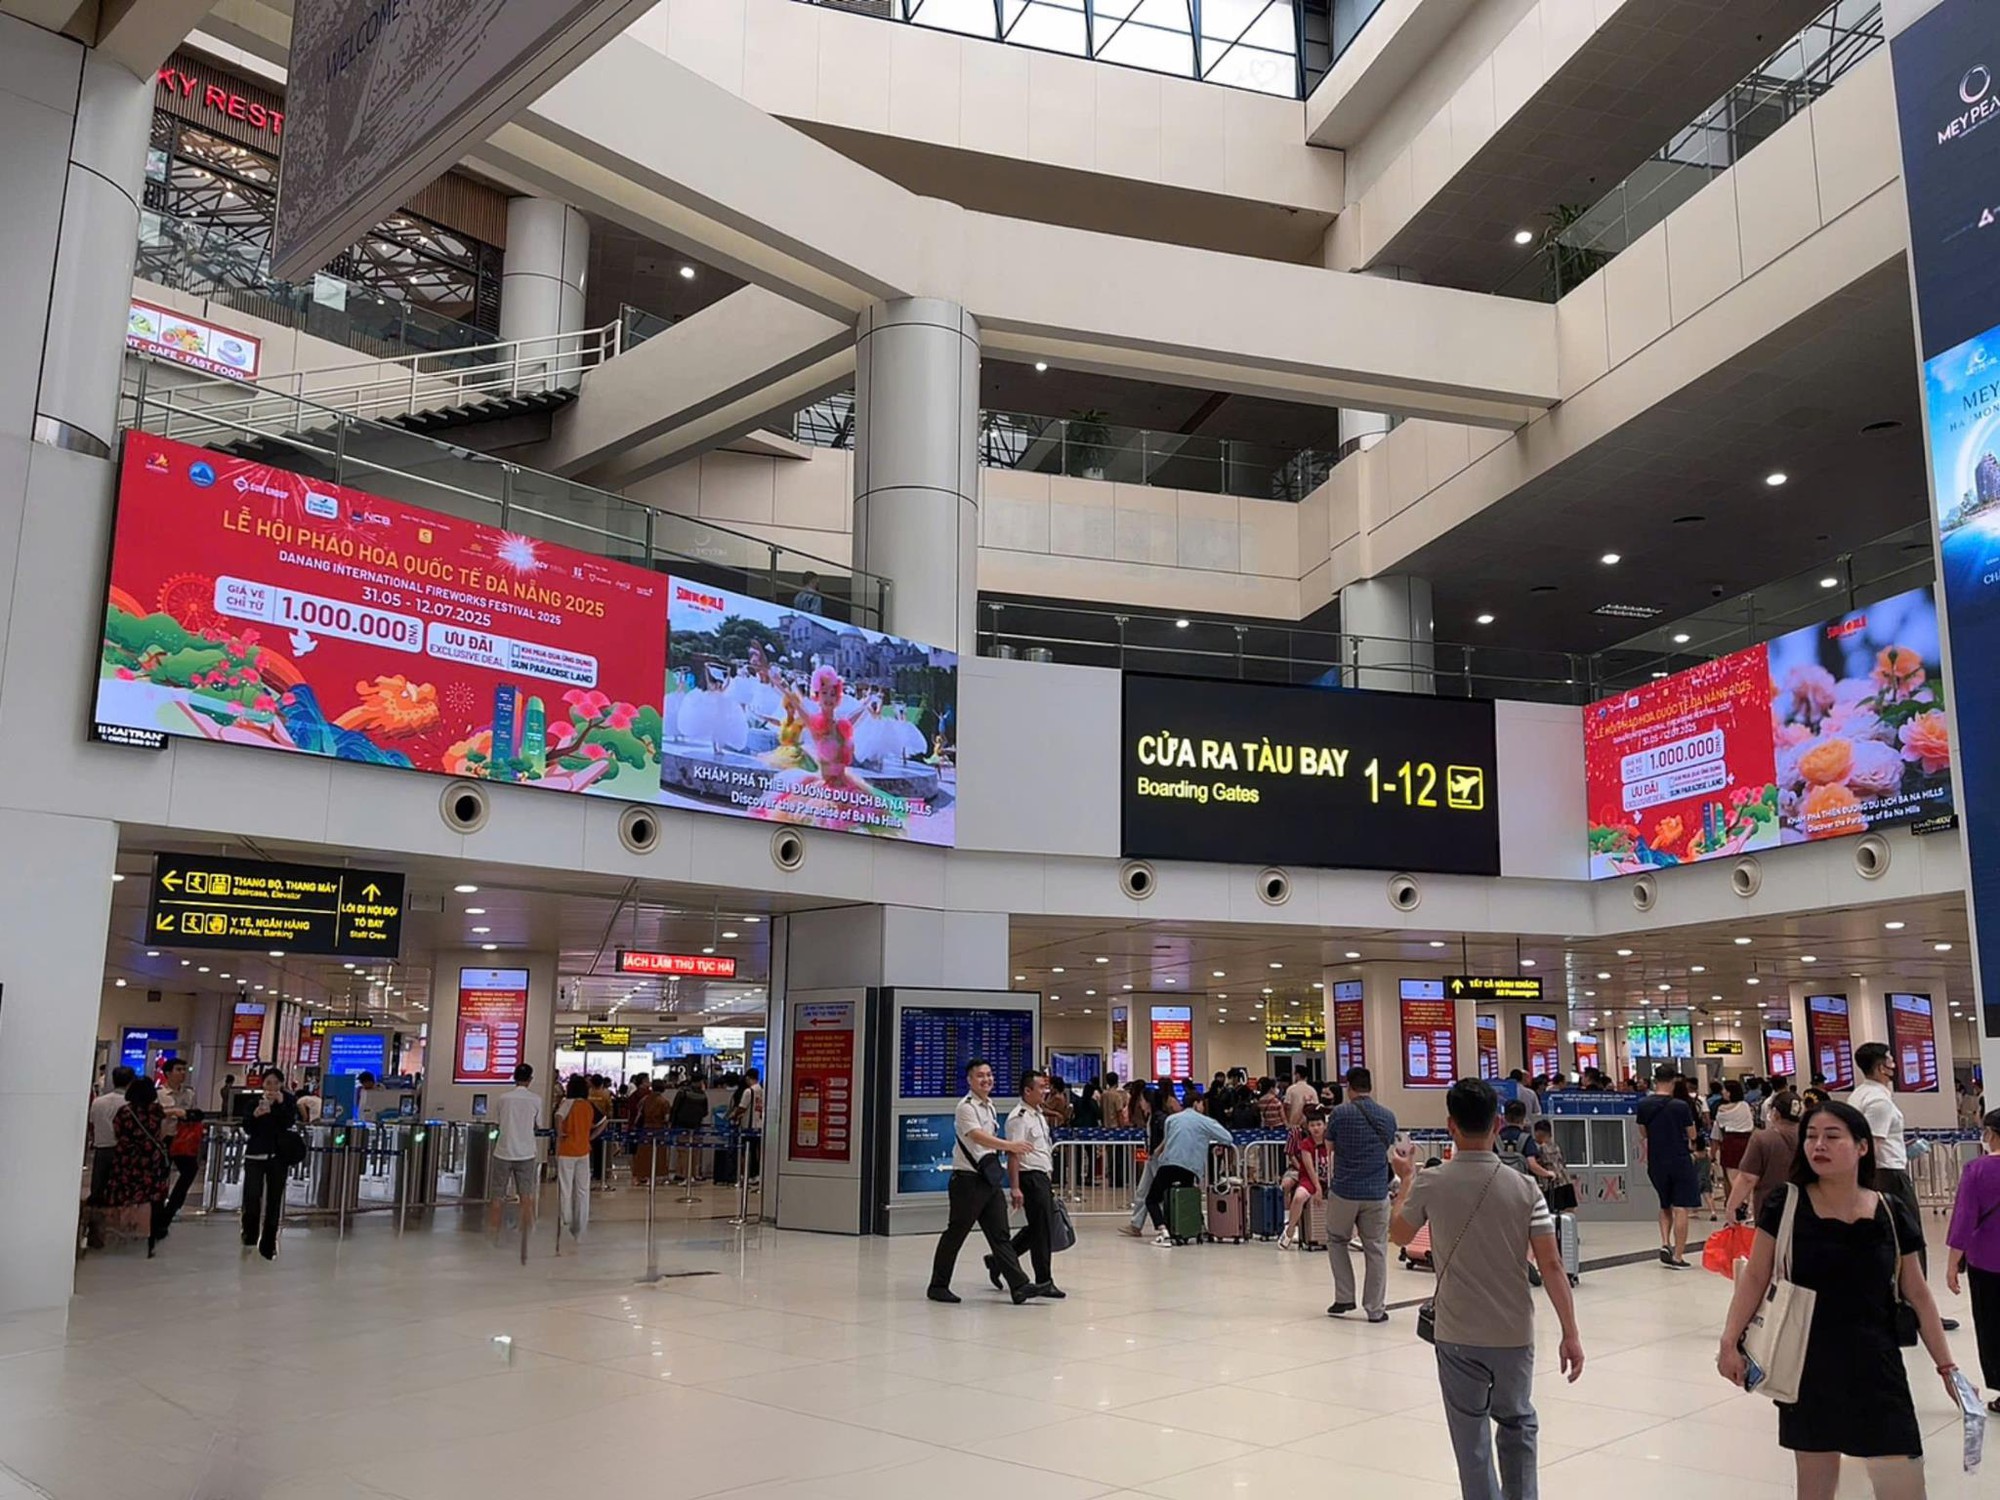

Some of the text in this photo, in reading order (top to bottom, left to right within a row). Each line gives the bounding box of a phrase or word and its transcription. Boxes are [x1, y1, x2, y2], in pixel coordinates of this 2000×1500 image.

[205, 84, 285, 136] REST
[148, 343, 178, 360] CAFE
[185, 354, 212, 371] FAST
[223, 506, 605, 619] LỄ HỘI PHÁO HOA QUỐC TẾ ĐÀ NẴNG 2025
[279, 550, 562, 626] DANANG INTERNATIONAL FIREWORKS FESTIVAL 2025
[282, 596, 419, 645] 1.000.000 VND
[362, 586, 401, 607] 31.05
[416, 599, 492, 627] 12.07.2025
[430, 644, 480, 663] EXCLUSIVE
[481, 654, 505, 668] DEAL
[468, 634, 493, 653] ĐÃI
[511, 659, 528, 671] SUN
[530, 663, 569, 680] PARADISE
[571, 672, 593, 684] LAND
[1137, 730, 1349, 778] CỬA RA TÀU BAY
[1650, 737, 1714, 770] 1.000.000
[694, 766, 730, 783] KHÁM
[732, 771, 756, 787] PHÁ
[1137, 777, 1260, 804] Boarding Gates
[1364, 757, 1438, 807] 1-12
[731, 791, 777, 809] Discover
[233, 876, 266, 888] THANG
[285, 880, 316, 892] THANG
[229, 926, 247, 937] First
